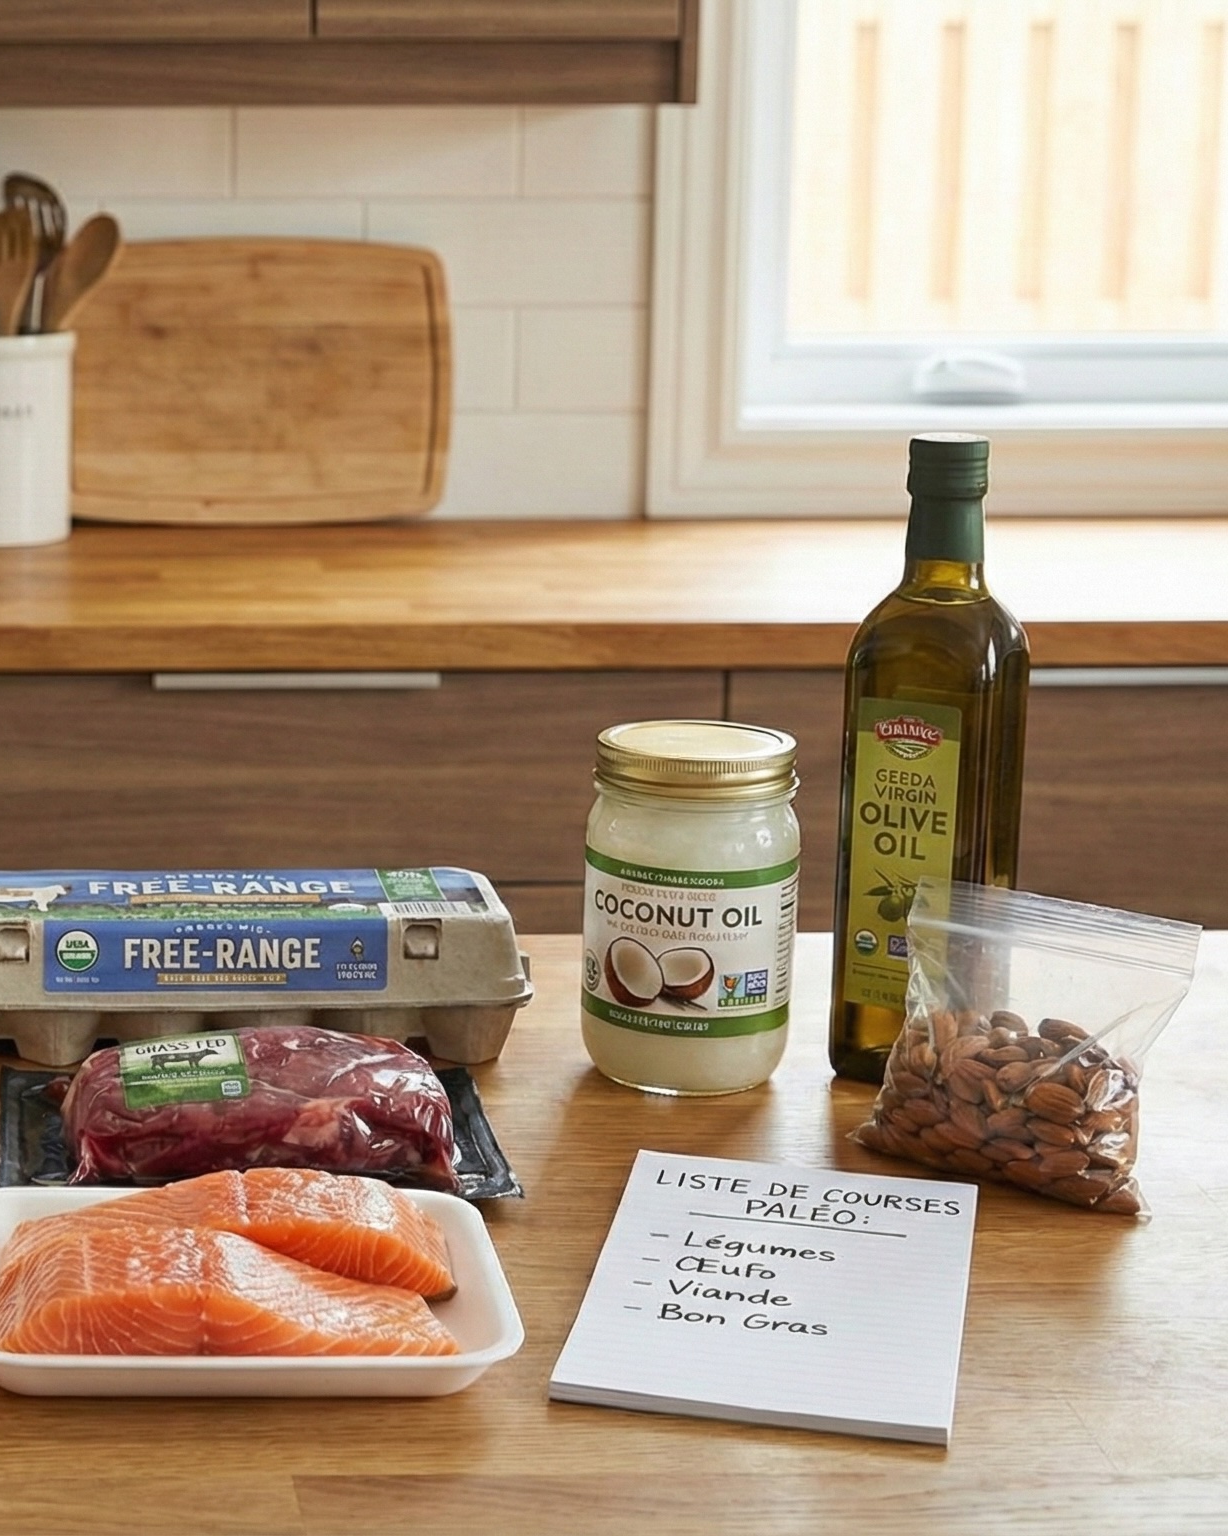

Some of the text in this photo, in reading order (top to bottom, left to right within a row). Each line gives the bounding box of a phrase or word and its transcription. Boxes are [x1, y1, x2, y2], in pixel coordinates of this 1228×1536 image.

[874, 783, 937, 806] VIRGIN
[875, 768, 936, 790] GEEDA
[859, 801, 949, 836] OLIVE
[873, 831, 926, 861] OIL
[88, 880, 355, 896] FREE-RANGE
[594, 889, 714, 928] COCONUT
[721, 905, 763, 928] OIL
[124, 938, 321, 969] FREE-RANGE
[656, 1169, 961, 1216] LISTE DE COURSES
[684, 1231, 837, 1263] Légumes
[669, 1279, 792, 1307] Viande
[657, 1303, 829, 1336] Bon Gras
